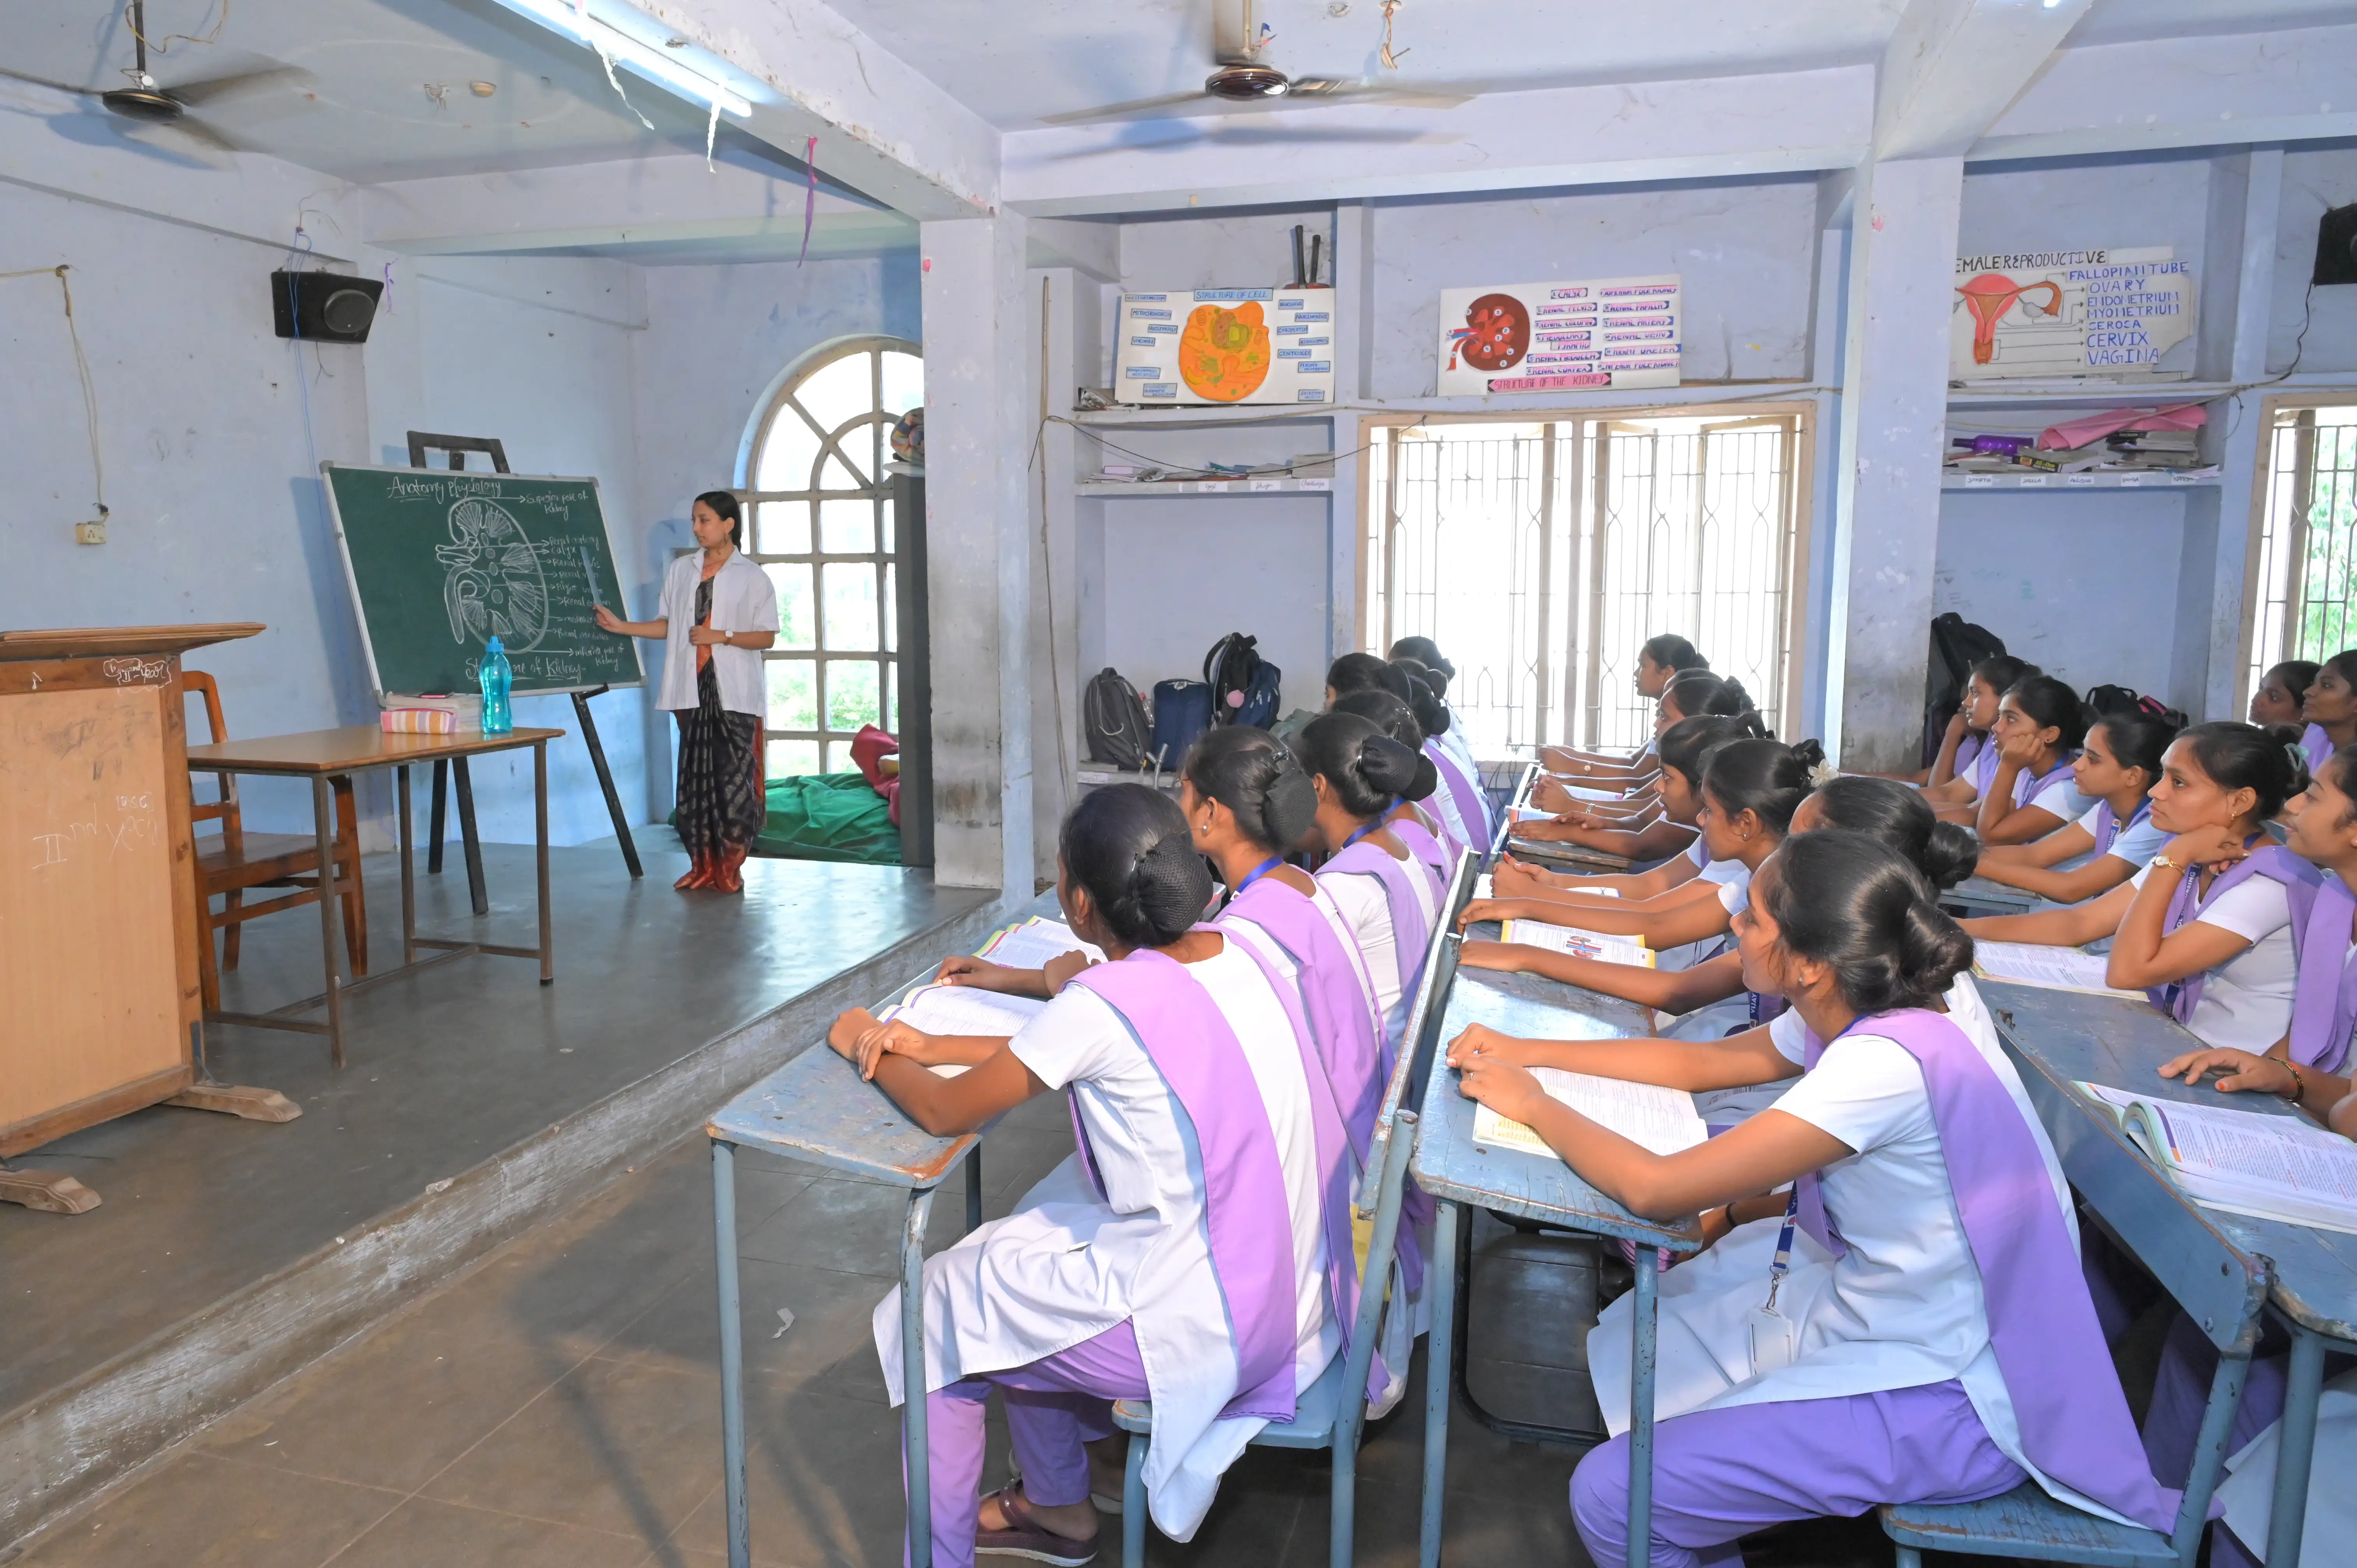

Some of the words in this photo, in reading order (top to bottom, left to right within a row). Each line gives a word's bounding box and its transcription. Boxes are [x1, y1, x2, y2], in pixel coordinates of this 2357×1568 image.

[2003, 251, 2107, 269] REPRODUCTIVE
[2069, 265, 2145, 280] FALLOPIAN
[2149, 261, 2189, 274] TUBE
[2090, 279, 2145, 293] OVARY
[1196, 291, 1235, 299] STRUCTURE
[2087, 291, 2179, 307] ENDOMETRIUM
[2087, 304, 2179, 318] MYOMETRIUM
[2087, 330, 2149, 348] CERVIX
[2087, 347, 2160, 365] VAGINA
[1494, 378, 1535, 390] STRUCTURE
[1540, 377, 1548, 387] OF
[1553, 376, 1566, 386] THE
[1573, 374, 1604, 385] KIDNEY
[387, 476, 444, 504] Anatomy
